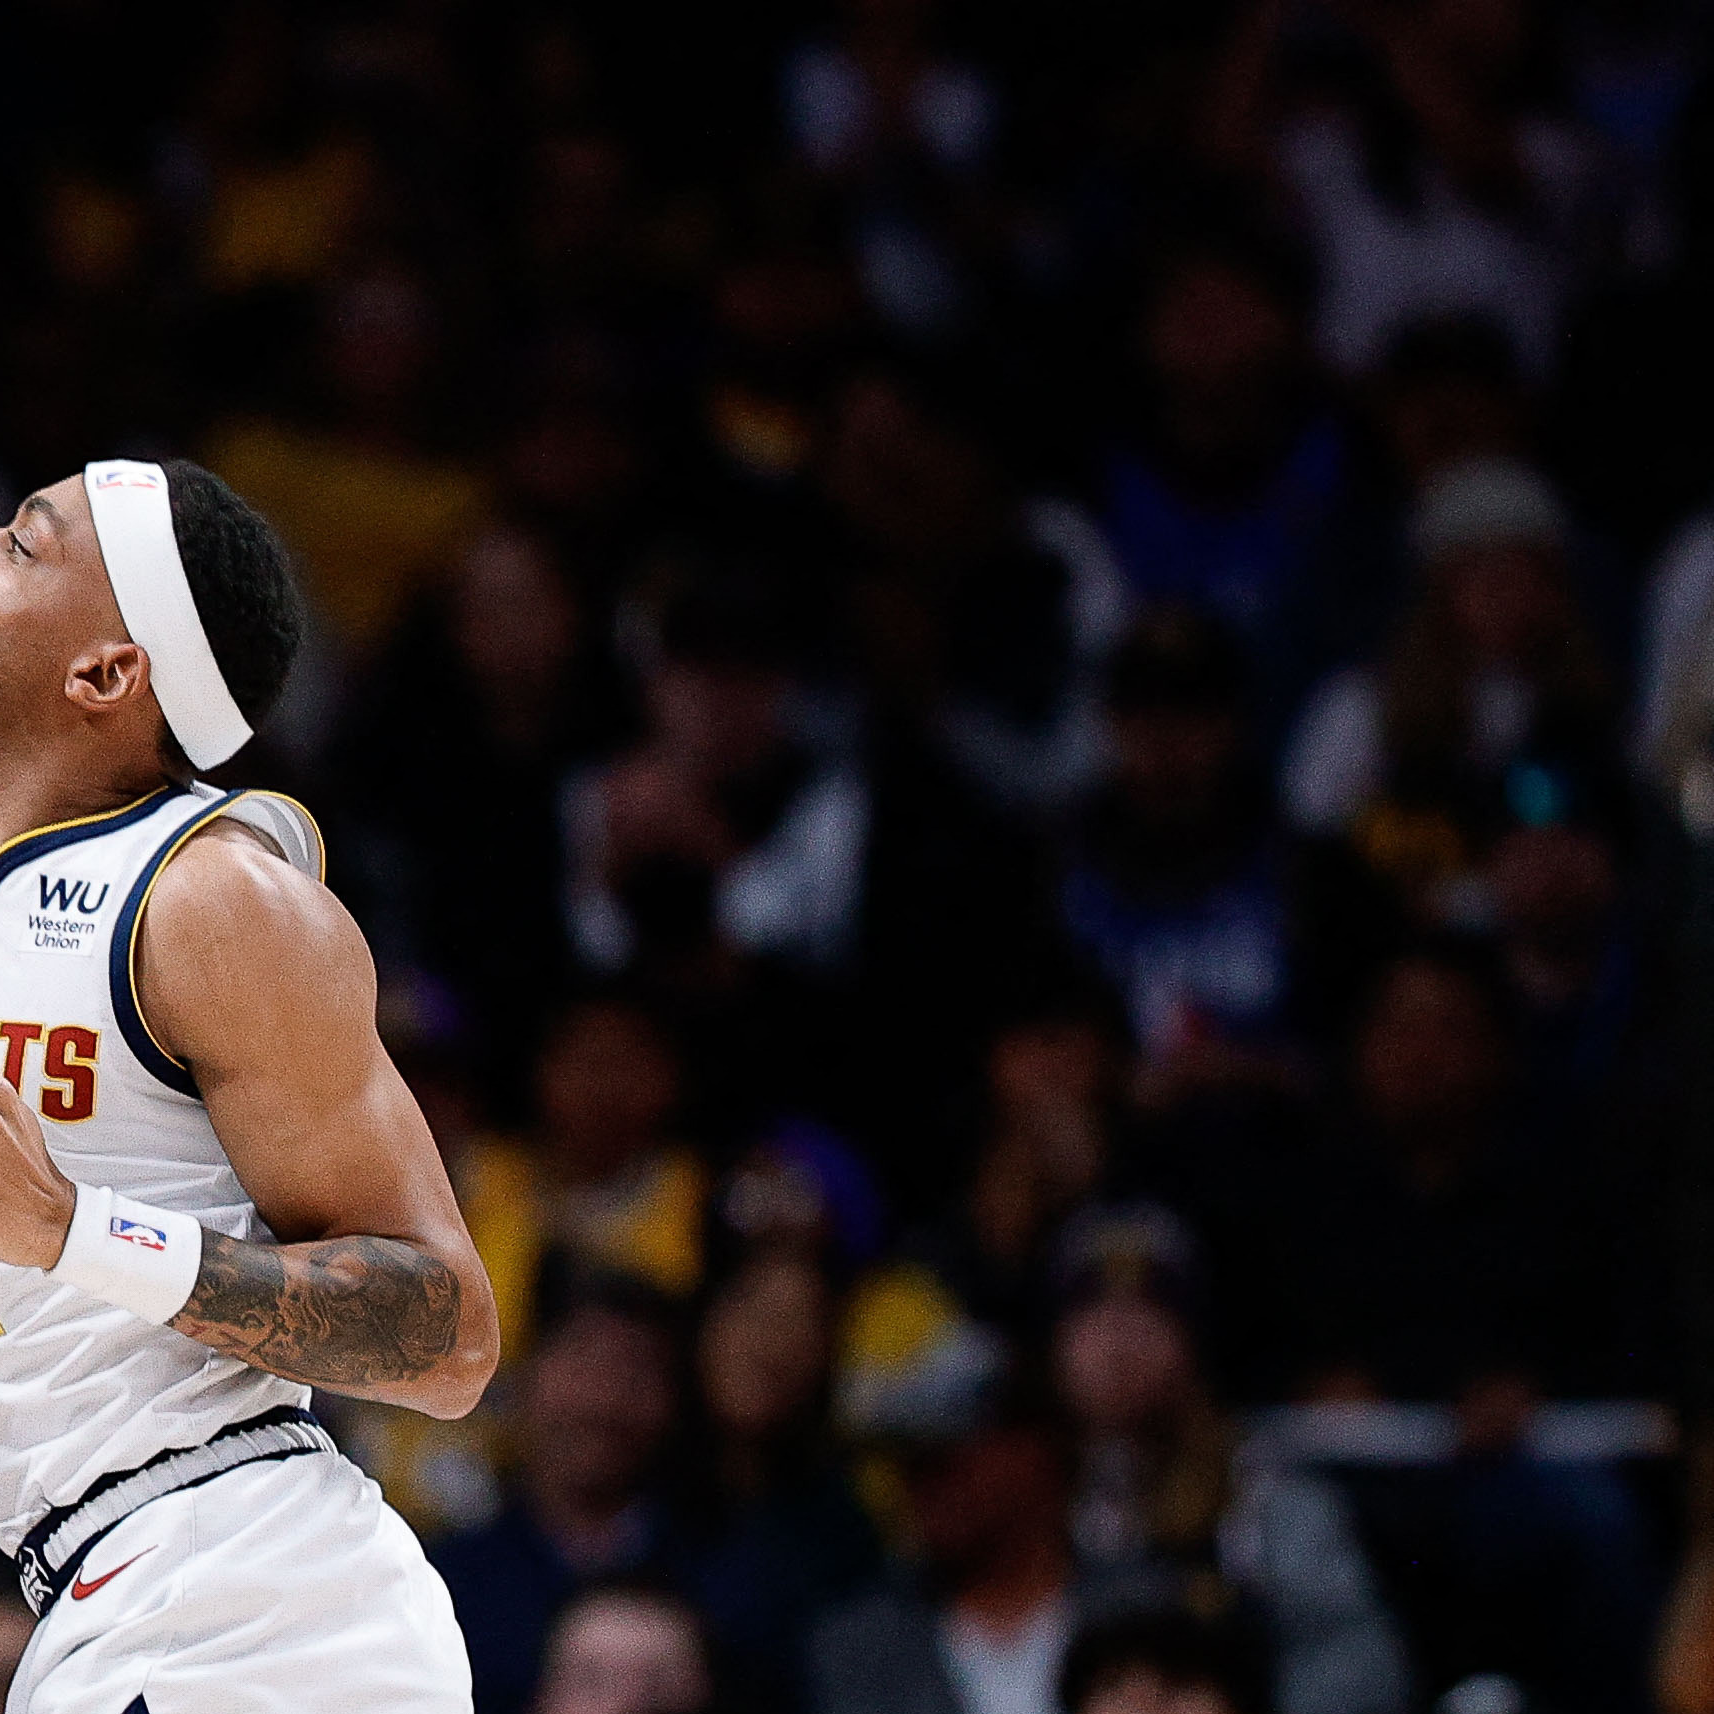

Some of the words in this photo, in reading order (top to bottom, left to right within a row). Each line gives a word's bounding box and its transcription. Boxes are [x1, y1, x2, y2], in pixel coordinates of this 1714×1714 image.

[39, 874, 110, 915] WU
[28, 914, 95, 934] Western
[34, 932, 80, 949] Union
